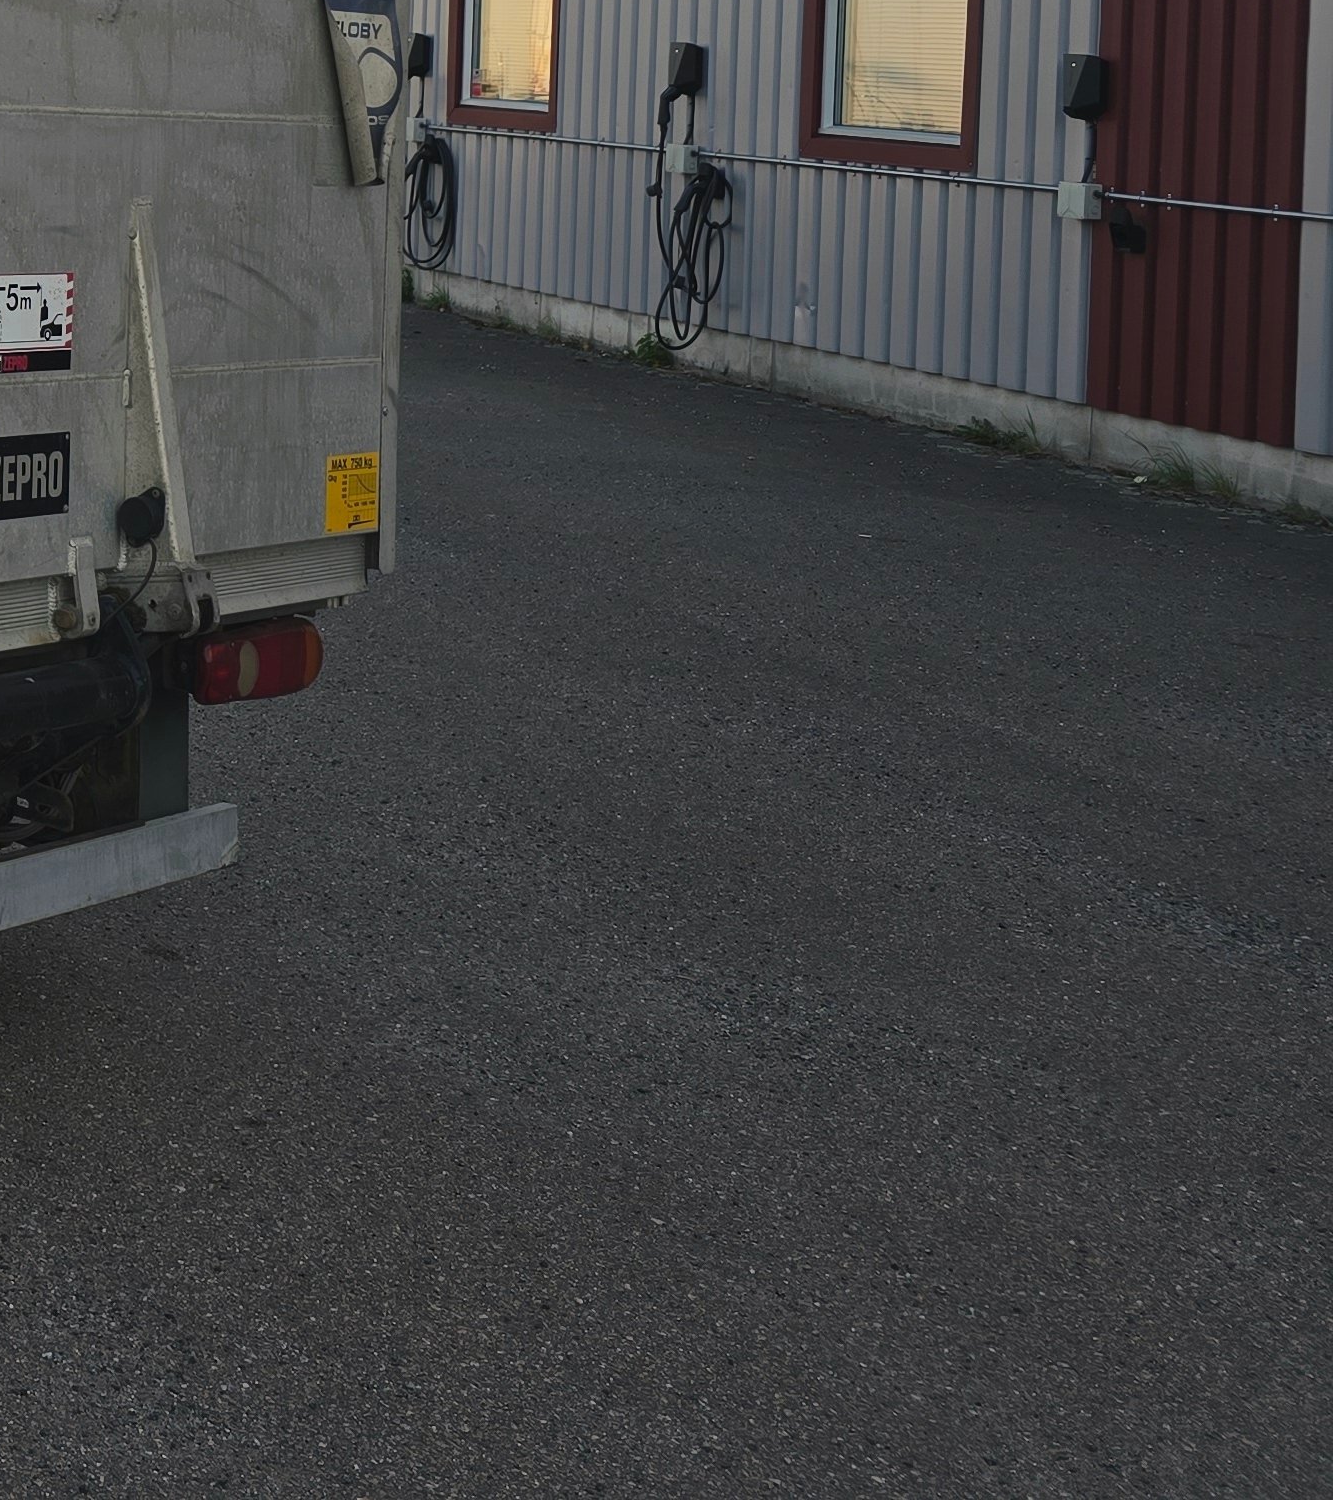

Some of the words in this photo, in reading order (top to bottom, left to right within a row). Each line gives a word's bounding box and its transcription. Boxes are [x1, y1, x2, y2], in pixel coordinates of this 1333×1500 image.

[335, 20, 383, 40] LOBY
[2, 355, 28, 372] ZEPRO
[331, 458, 347, 470] MAX
[351, 457, 362, 469] 750
[363, 456, 373, 469] kg
